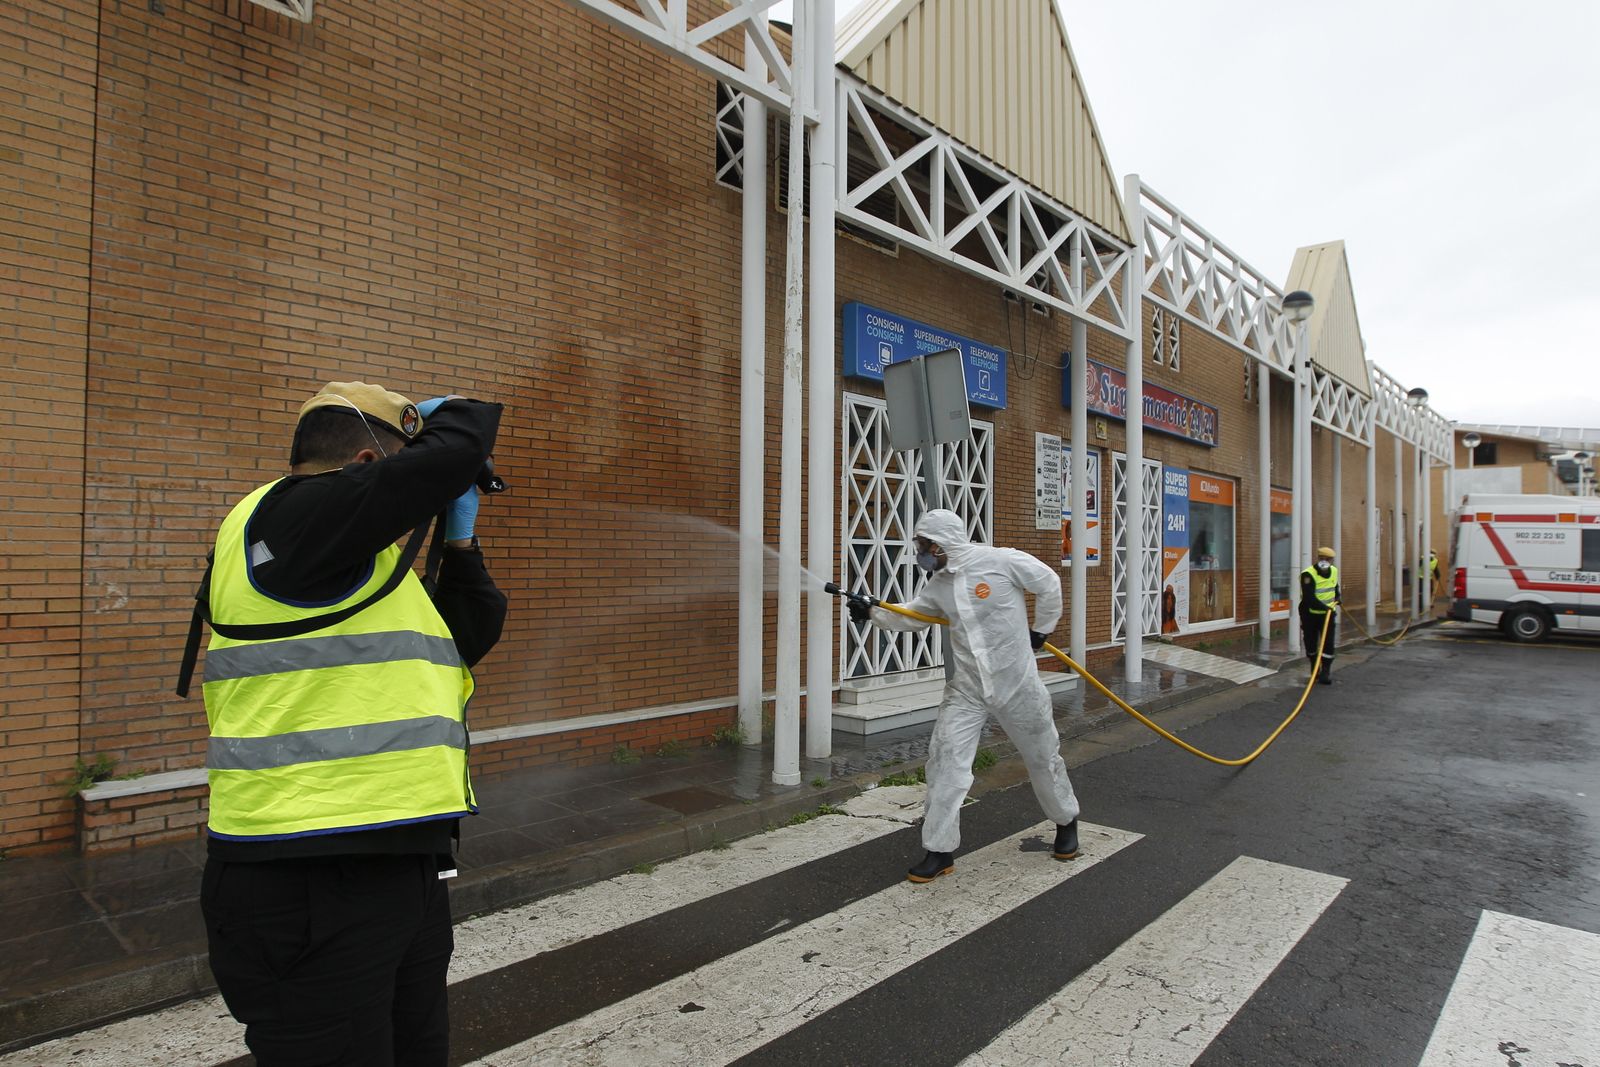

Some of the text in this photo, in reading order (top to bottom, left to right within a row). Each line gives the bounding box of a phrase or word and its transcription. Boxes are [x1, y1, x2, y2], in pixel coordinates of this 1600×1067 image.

[866, 313, 905, 334] CONSIGNA
[867, 326, 904, 345] CONSIGNE
[913, 328, 962, 350] SUPERMERCADO
[970, 346, 999, 362] TELEFONOS
[970, 356, 999, 372] TELEPHONE
[1100, 372, 1187, 427] Supmarché
[1165, 471, 1188, 487] SUPER
[1165, 485, 1188, 497] MERCADO
[1167, 513, 1185, 532] 24H
[1549, 571, 1597, 584] Cruz Roja
